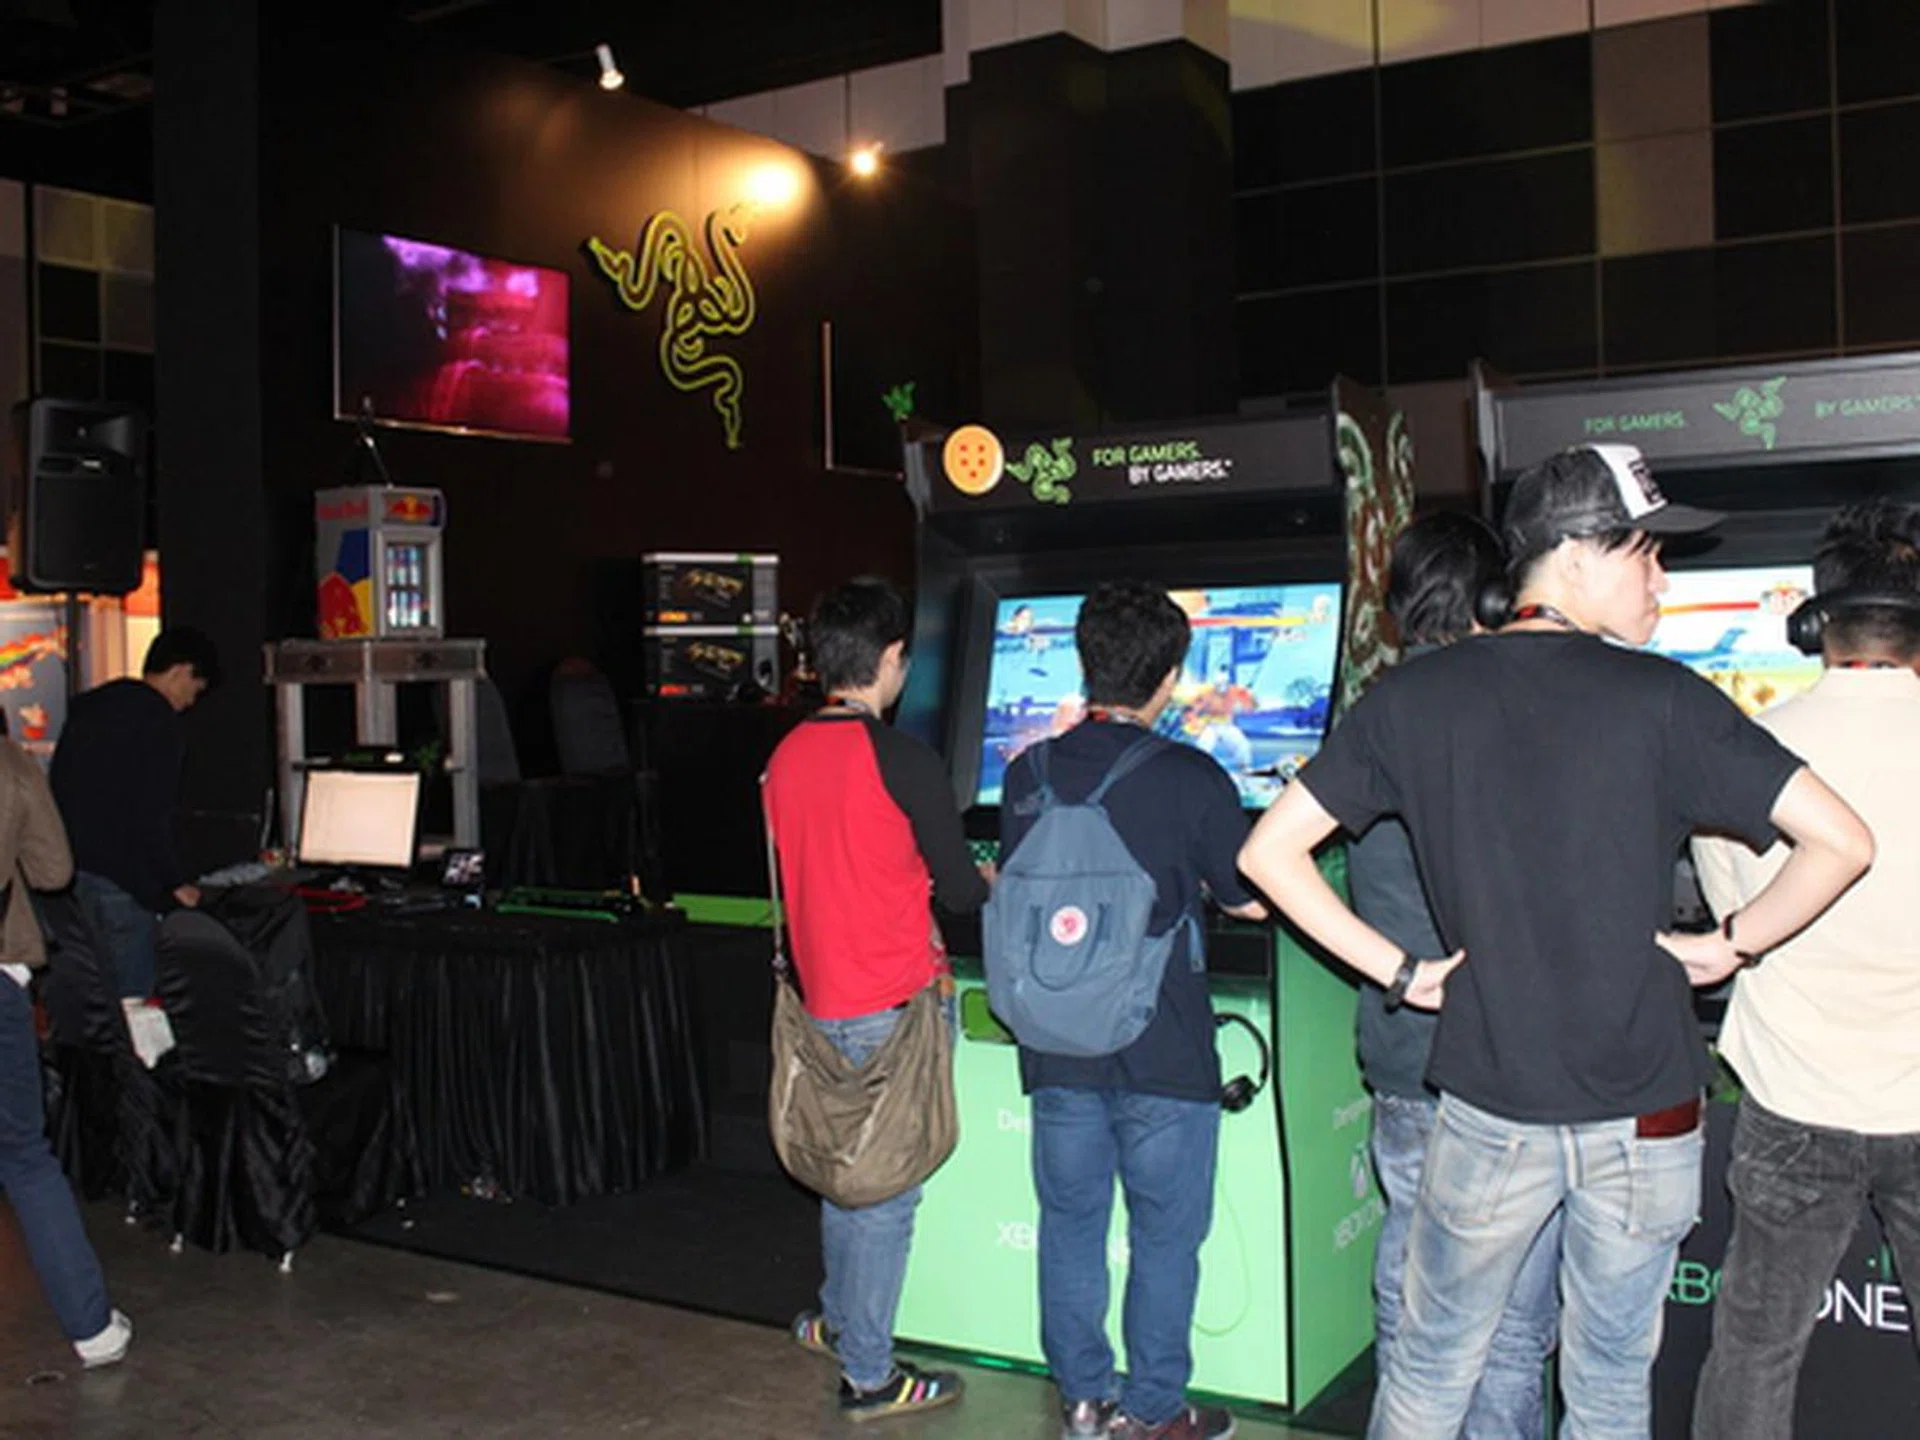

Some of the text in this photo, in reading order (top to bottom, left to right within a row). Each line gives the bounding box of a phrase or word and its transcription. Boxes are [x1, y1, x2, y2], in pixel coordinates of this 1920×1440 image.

[1584, 416, 1614, 435] FOR
[1815, 400, 1836, 419] BY
[1093, 446, 1126, 466] FOR
[1129, 465, 1150, 485] BY
[994, 1221, 1038, 1251] XB
